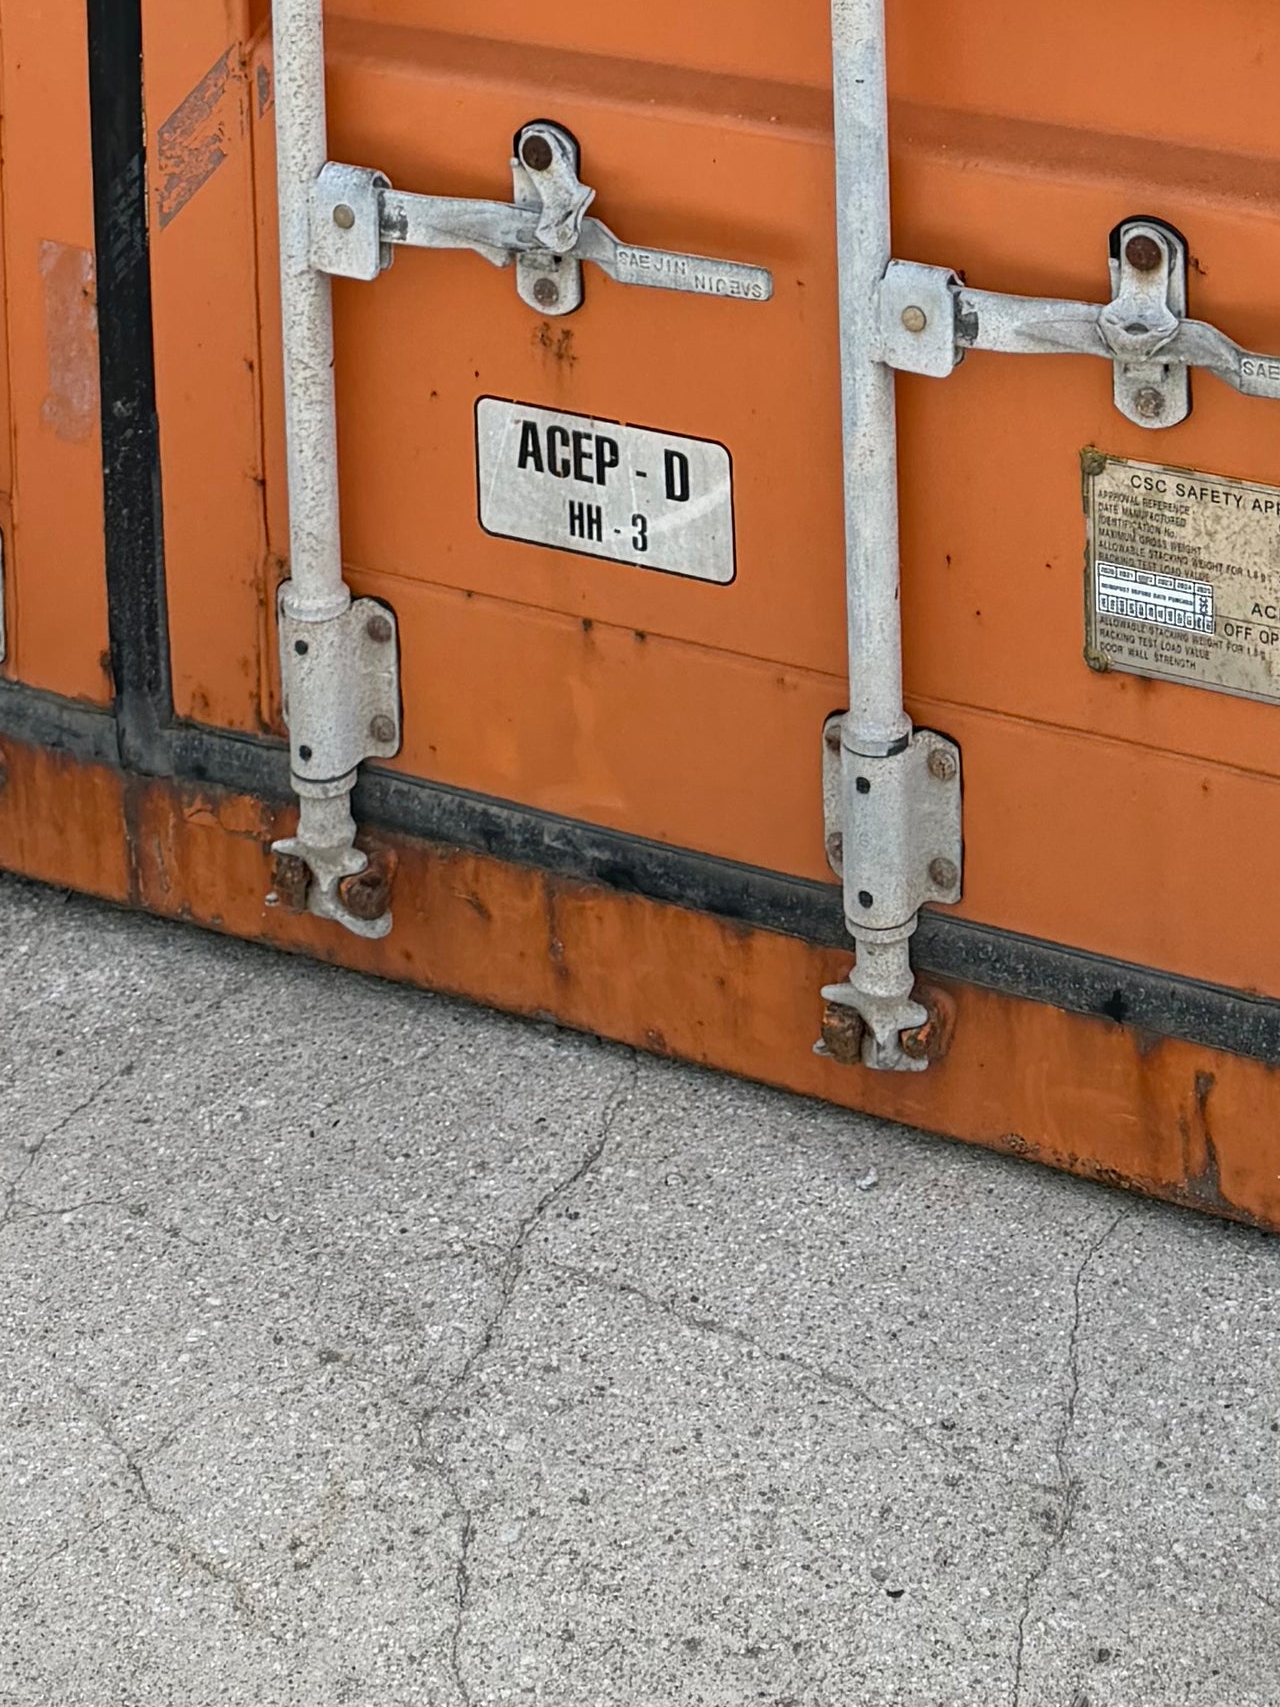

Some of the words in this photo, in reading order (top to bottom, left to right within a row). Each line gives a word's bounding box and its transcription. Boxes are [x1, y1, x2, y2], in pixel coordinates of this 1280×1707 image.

[517, 420, 619, 486] ACEP
[664, 448, 690, 502] D
[1130, 474, 1167, 494] CSC
[1175, 483, 1243, 509] SAFETY
[568, 499, 603, 543] HH
[631, 513, 648, 552] 3
[1223, 622, 1253, 640] OFF
[1138, 636, 1157, 648] TEST
[1160, 641, 1182, 654] LOAD
[1154, 651, 1197, 669] STRENGTH
